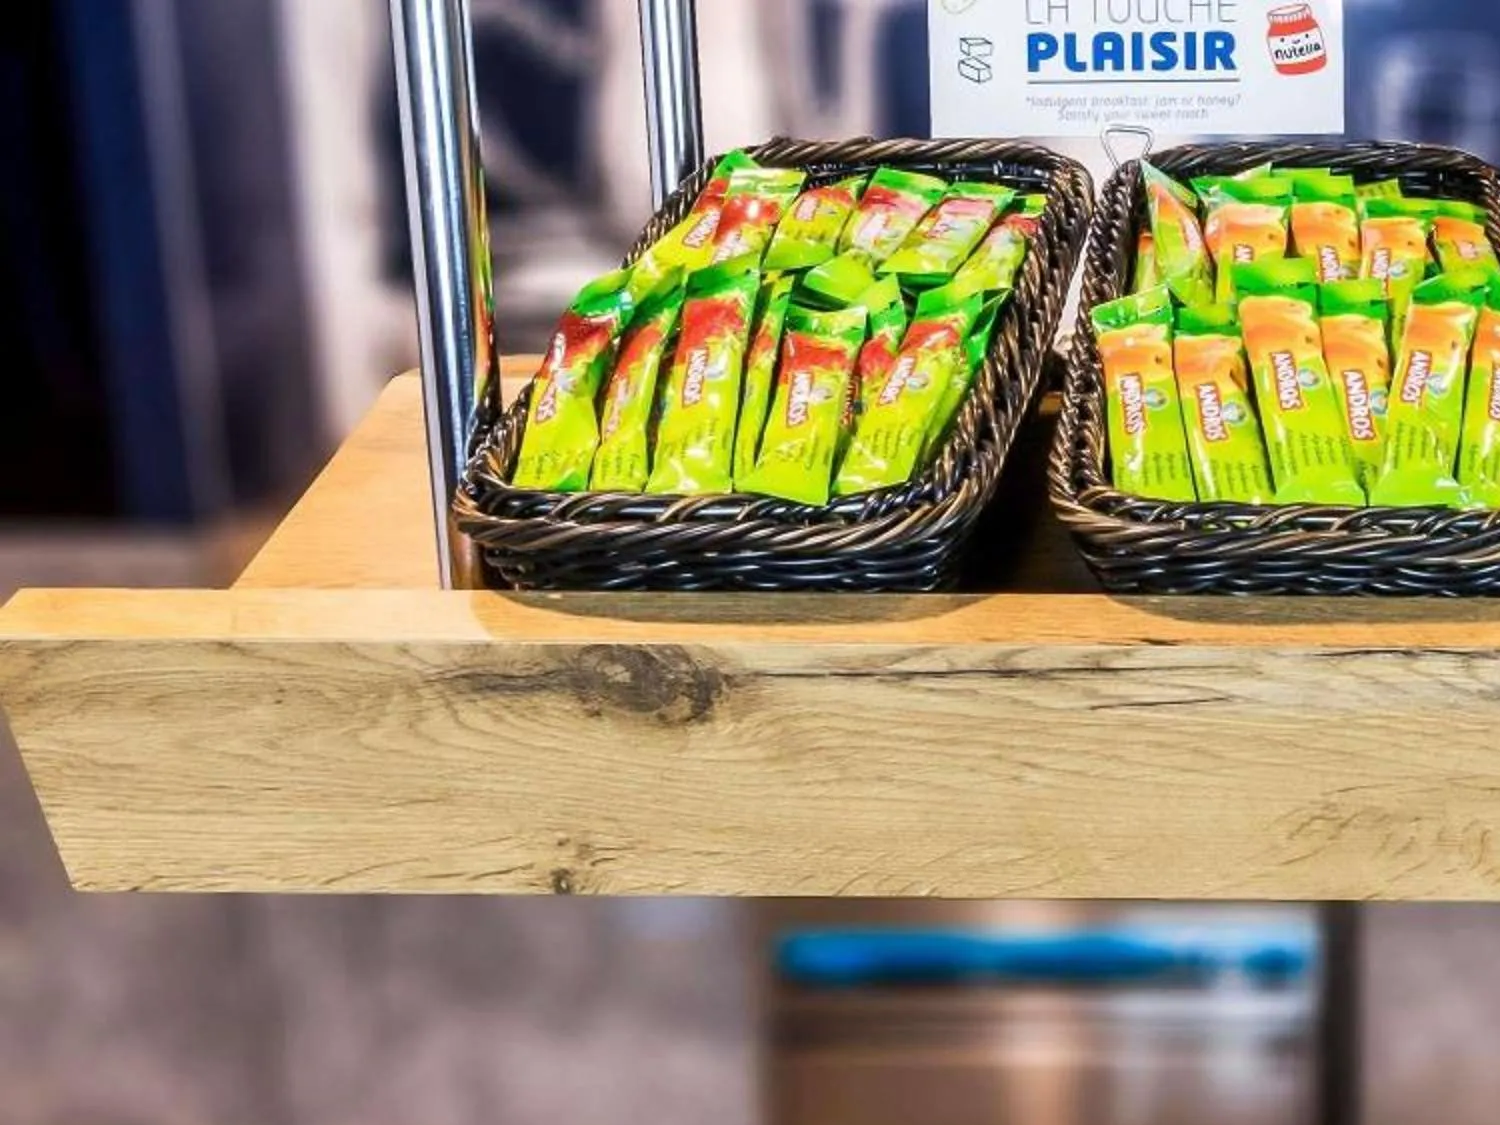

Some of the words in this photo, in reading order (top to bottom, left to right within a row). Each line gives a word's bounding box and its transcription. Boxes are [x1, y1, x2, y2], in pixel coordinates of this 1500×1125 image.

[1027, 32, 1237, 73] PLAISIR
[1274, 40, 1324, 61] nutella
[1199, 384, 1226, 441] ANDROS
[1343, 371, 1374, 440] ANDROS
